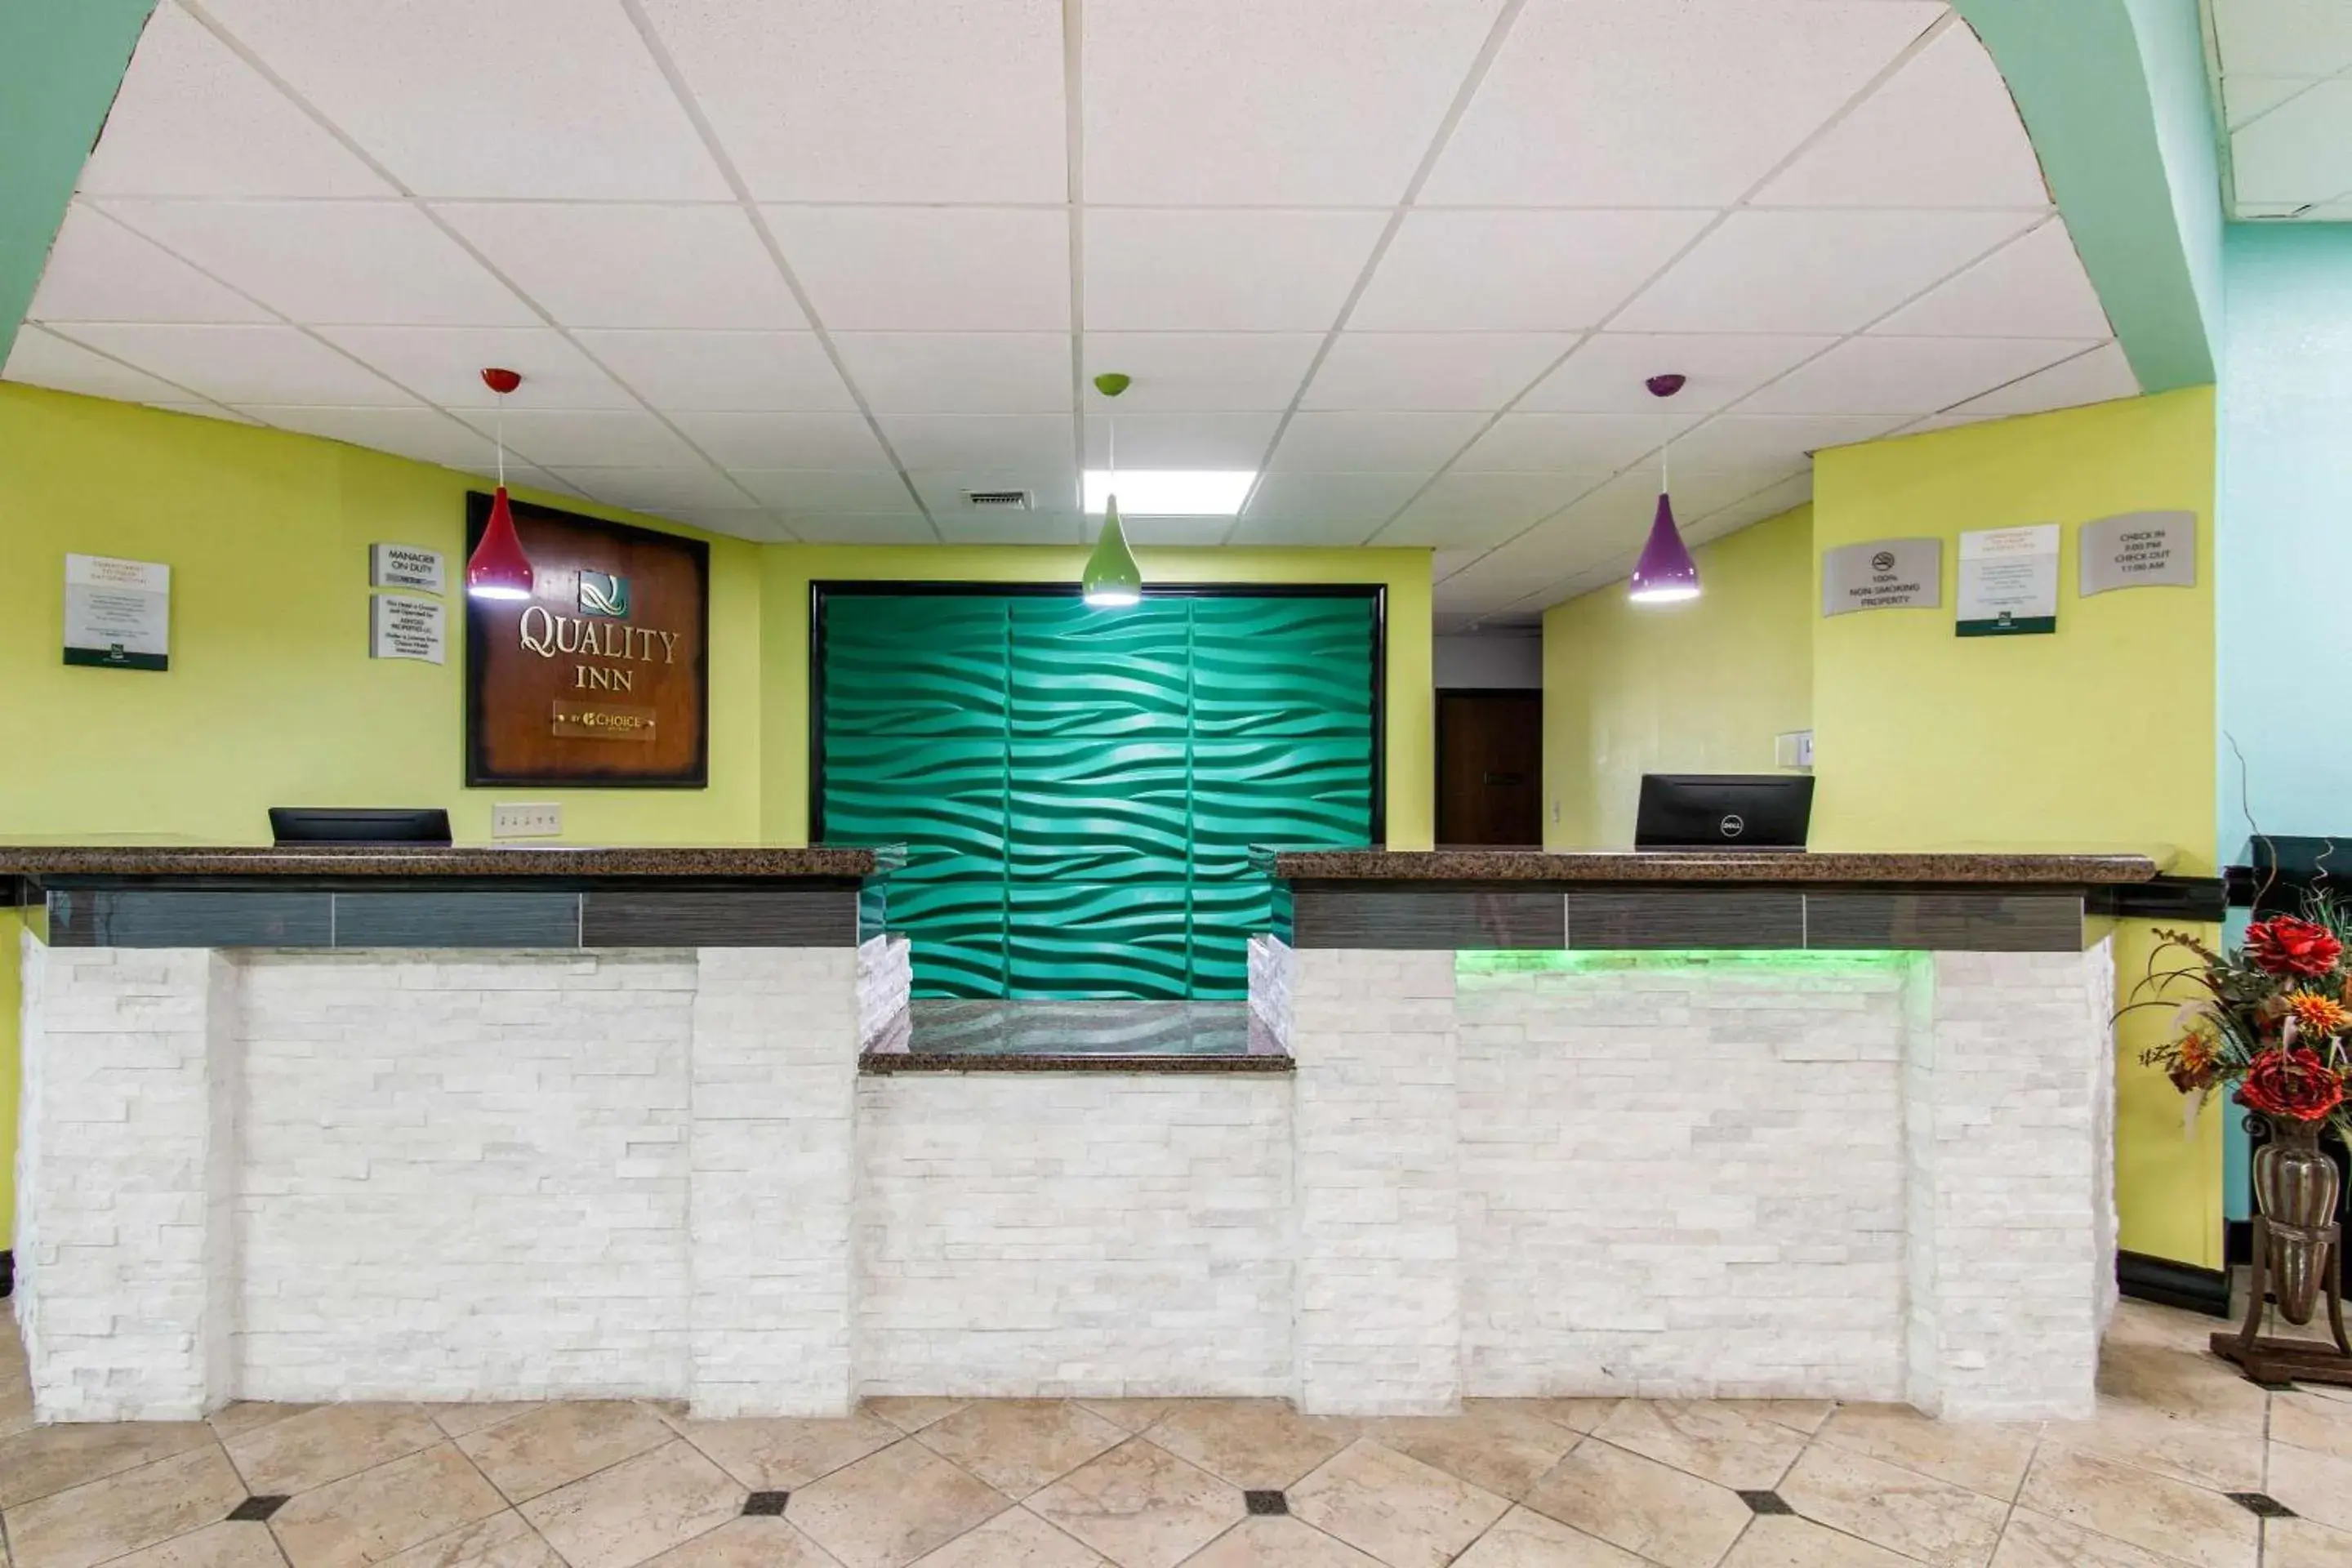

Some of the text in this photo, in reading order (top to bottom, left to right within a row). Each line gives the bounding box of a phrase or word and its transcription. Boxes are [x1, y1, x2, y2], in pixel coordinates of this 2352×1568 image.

[2120, 529, 2166, 542] CHECK IN
[2145, 541, 2162, 550] PM
[388, 550, 435, 564] MANAGER
[2114, 549, 2171, 563] CHECK OUT
[391, 560, 432, 573] ON DUTY
[2149, 561, 2165, 570] AM
[1860, 595, 1911, 607] PROPERTY
[519, 606, 681, 664] QUALITY
[575, 665, 634, 693] INN
[596, 713, 641, 728] CHOICE
